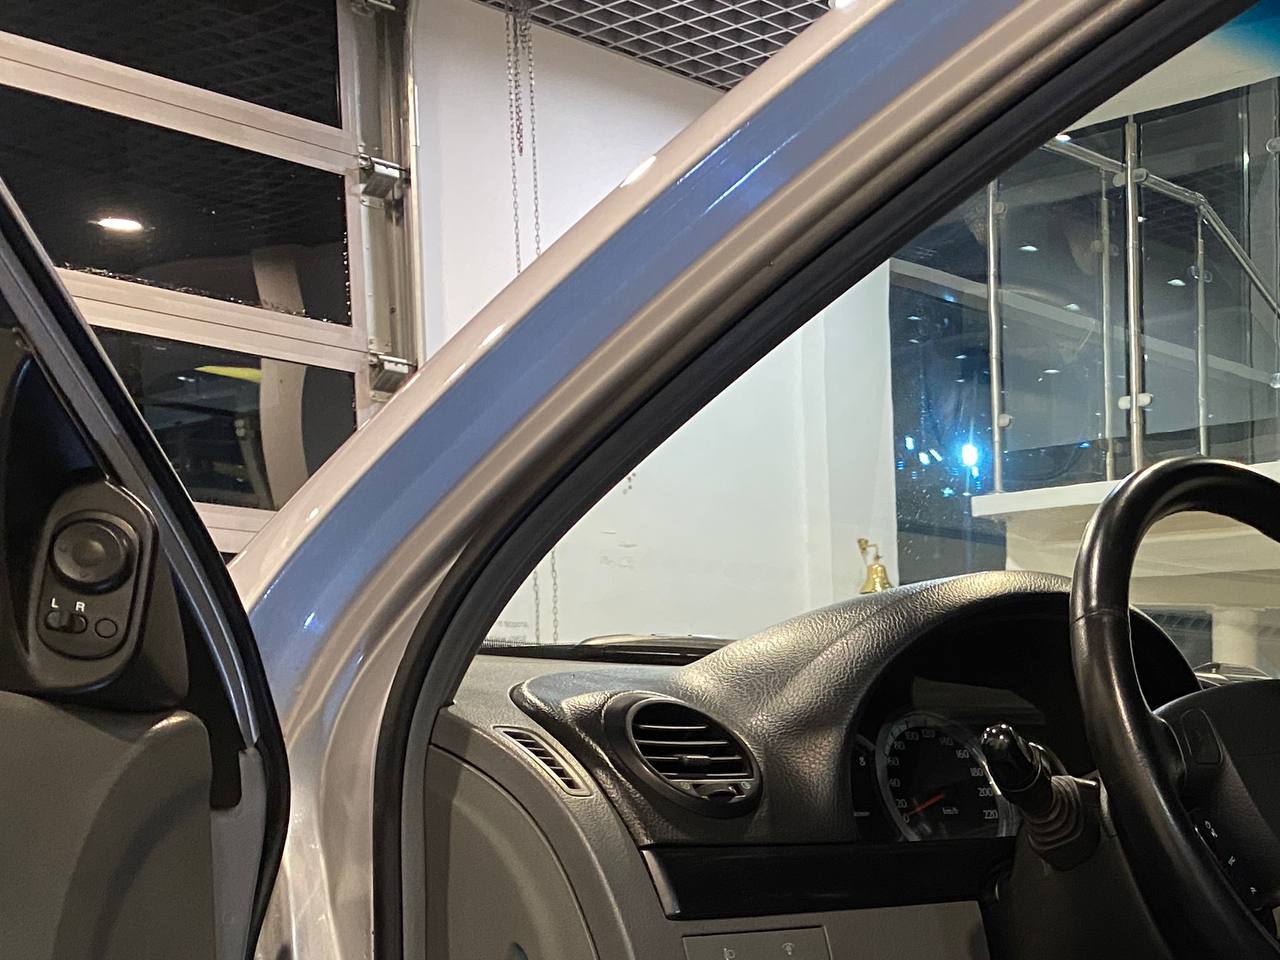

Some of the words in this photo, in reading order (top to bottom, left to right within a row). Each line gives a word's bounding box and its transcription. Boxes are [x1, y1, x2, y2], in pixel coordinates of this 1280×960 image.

[51, 598, 59, 608] L
[75, 601, 86, 612] R
[955, 749, 970, 759] 160
[970, 767, 984, 777] 180
[978, 787, 993, 796] 200
[896, 799, 907, 809] 20
[983, 810, 998, 819] 220
